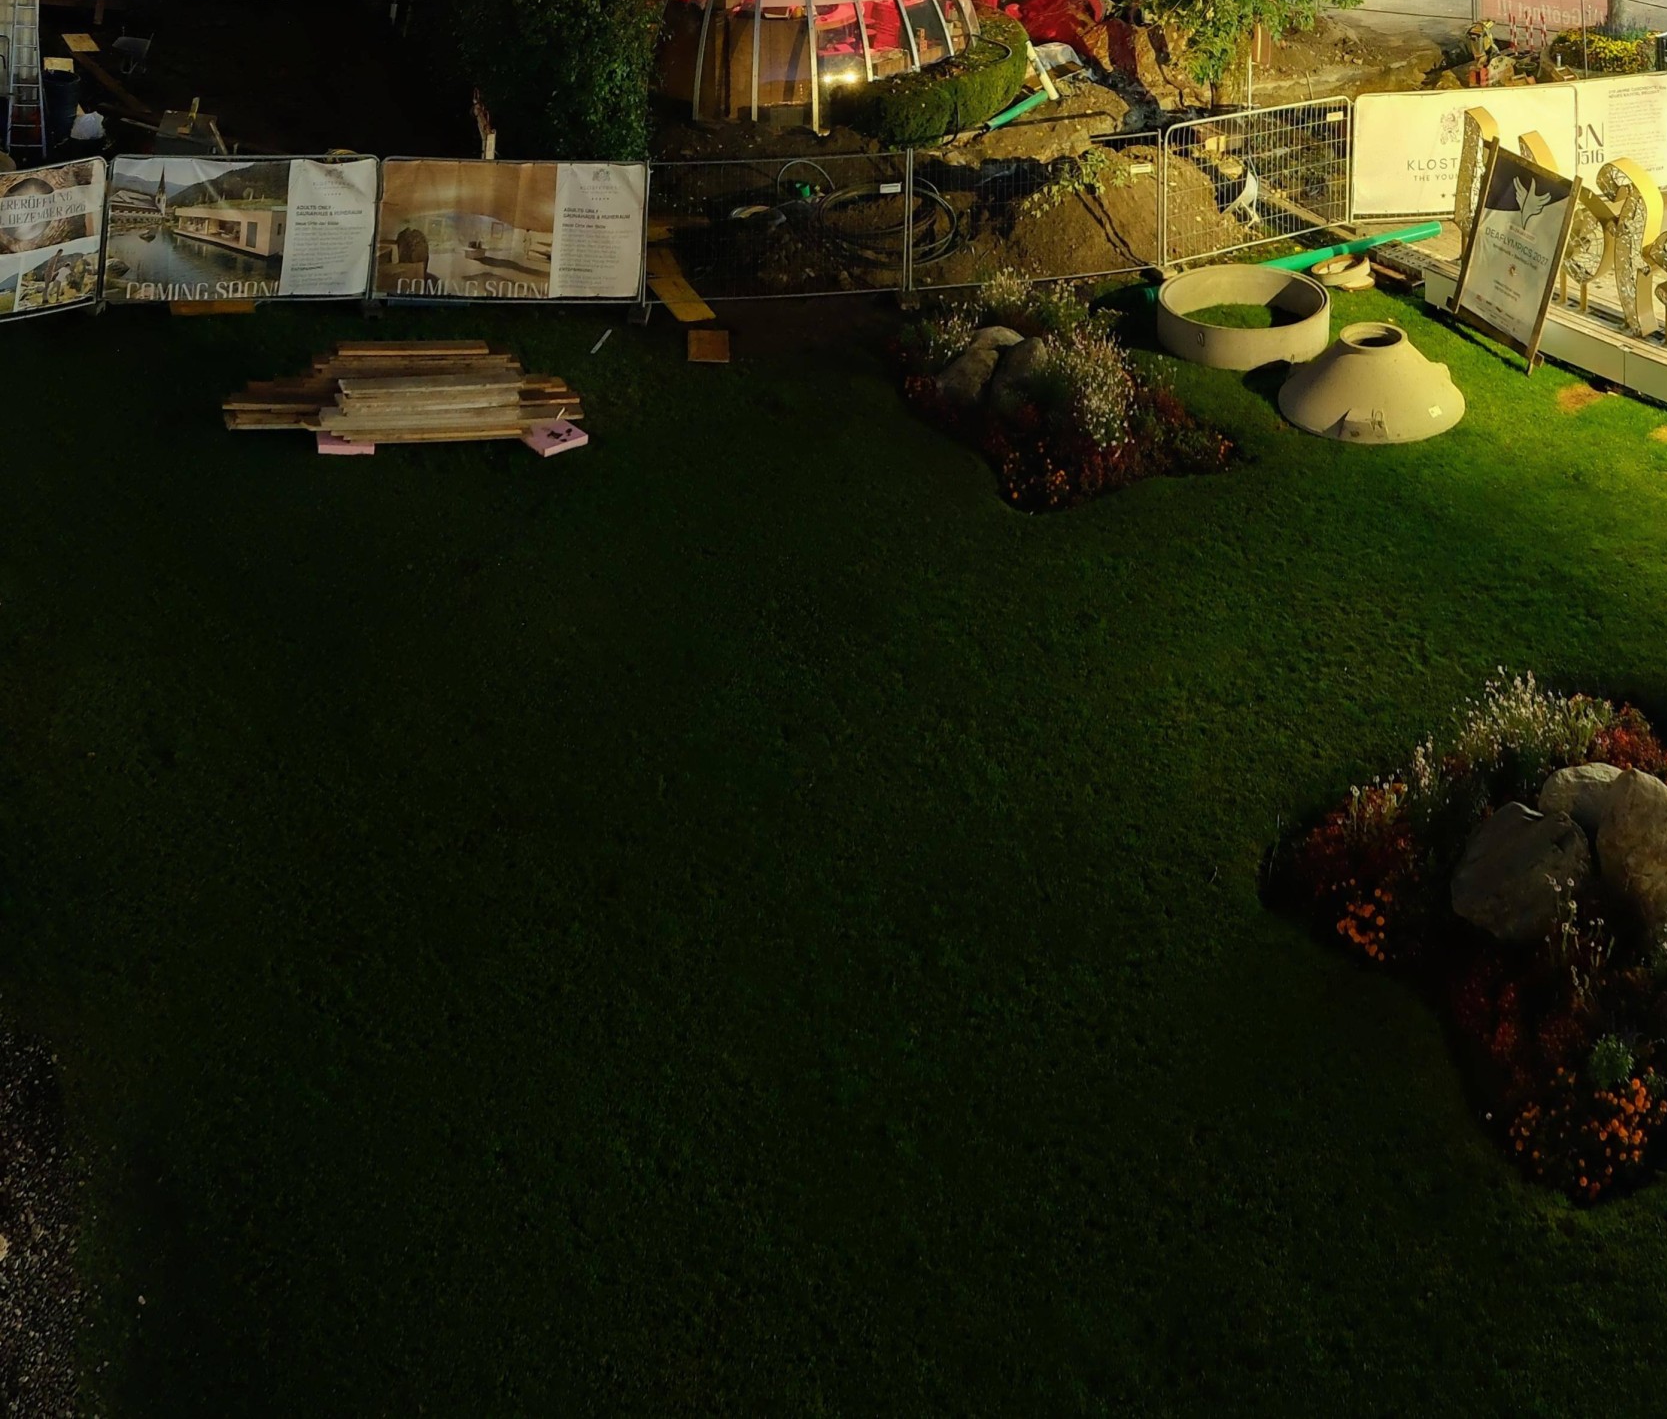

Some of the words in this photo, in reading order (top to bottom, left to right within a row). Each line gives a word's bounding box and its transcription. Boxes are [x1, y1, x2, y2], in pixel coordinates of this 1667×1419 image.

[1413, 174, 1430, 183] THE
[1485, 226, 1534, 261] DEAFLYMPICS
[1533, 250, 1549, 267] 2027
